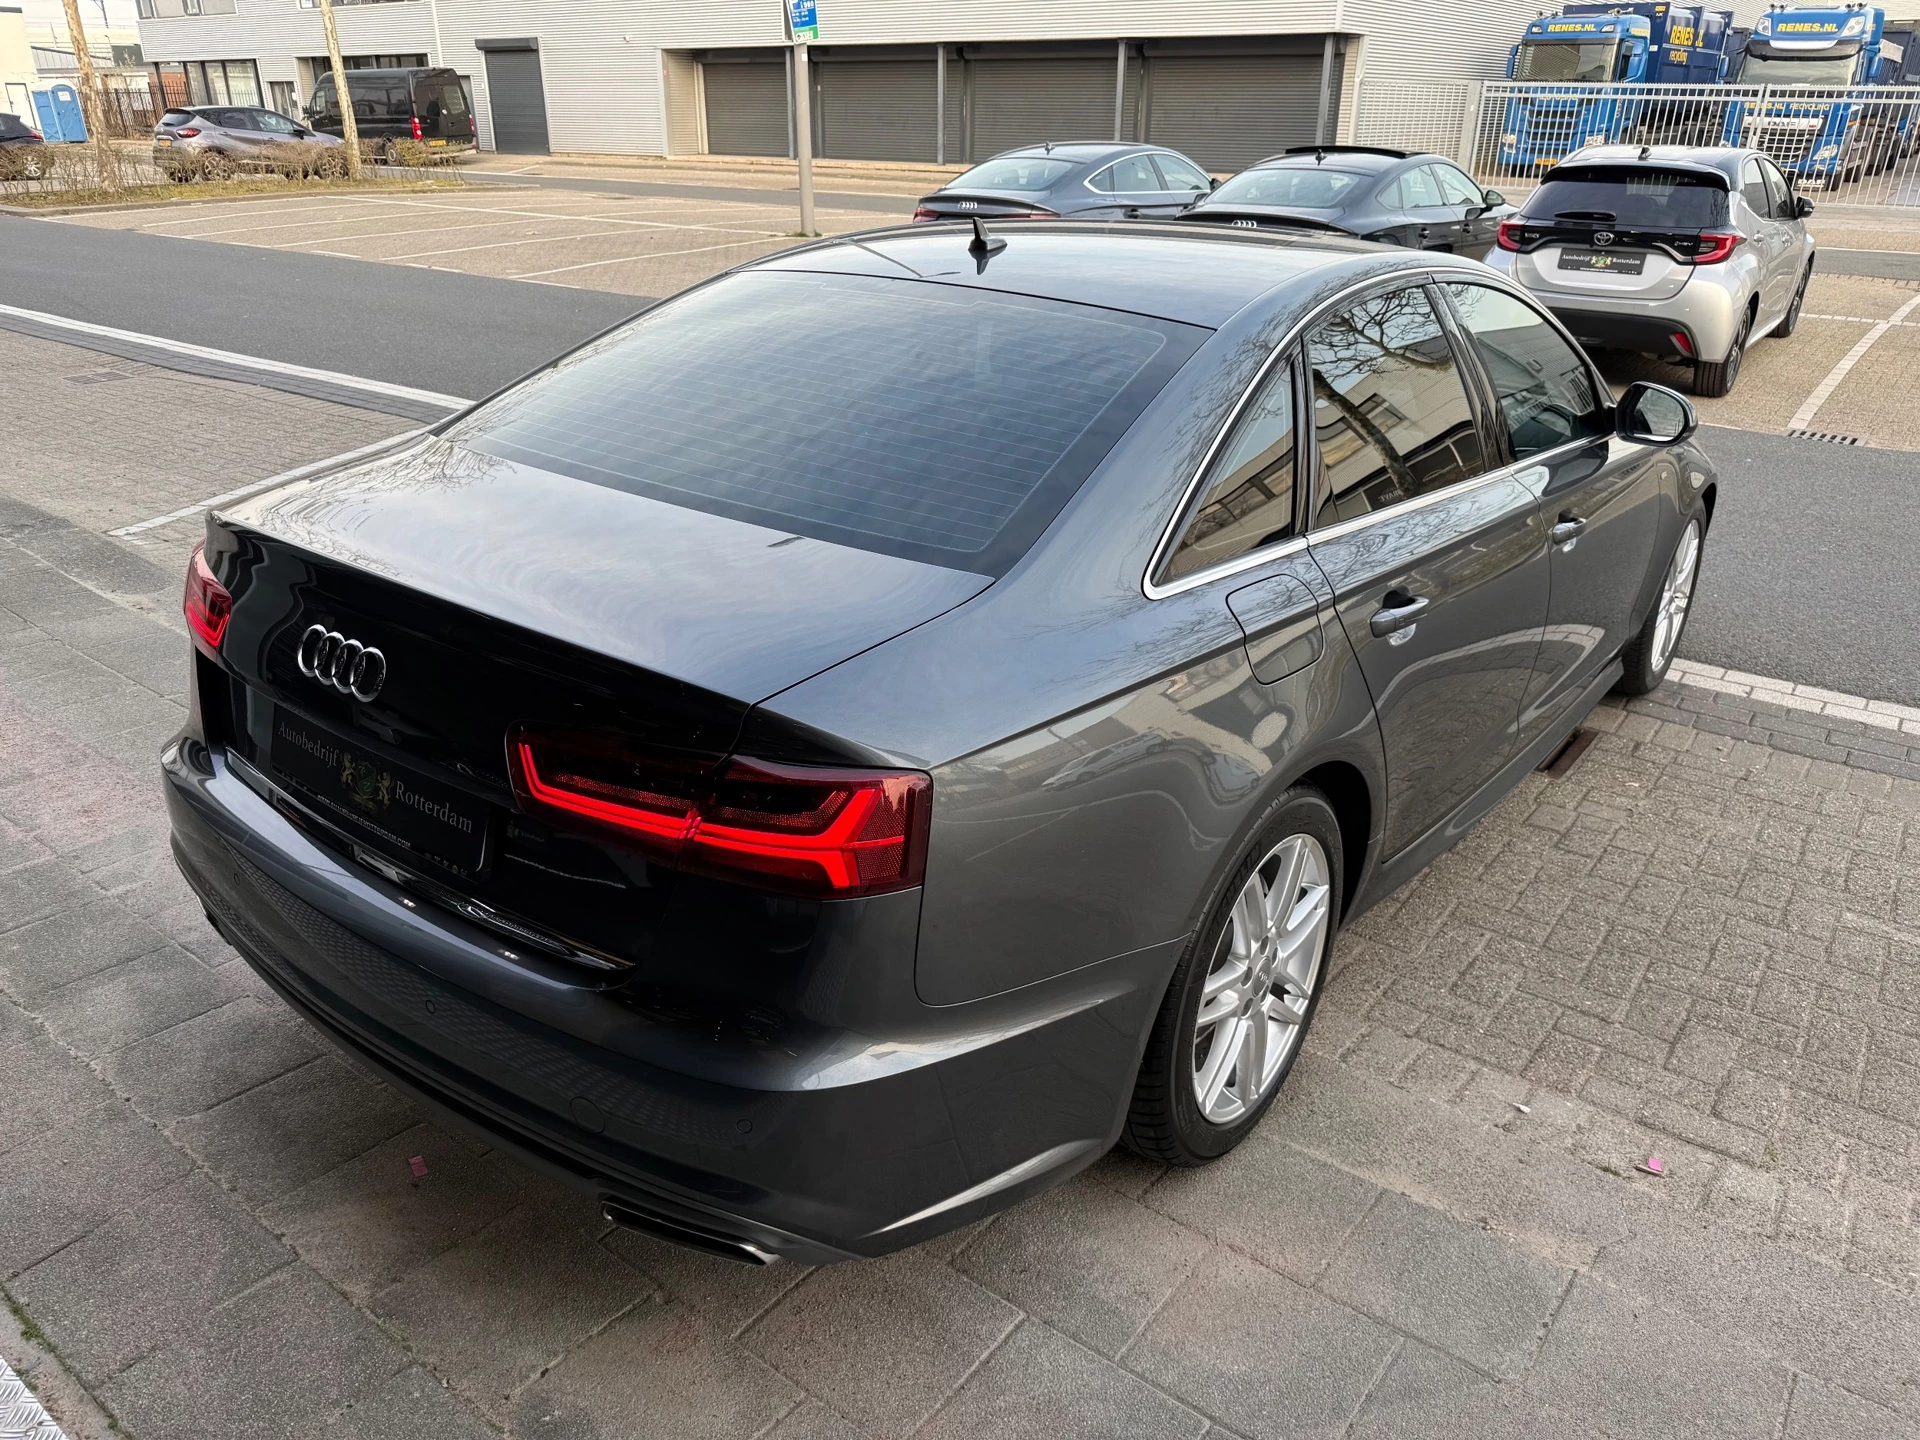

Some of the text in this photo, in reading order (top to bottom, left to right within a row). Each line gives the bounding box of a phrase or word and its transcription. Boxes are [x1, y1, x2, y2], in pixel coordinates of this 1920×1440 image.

[1548, 24, 1597, 32] RENES.NL
[1777, 23, 1838, 32] RENES.NL
[1744, 102, 1829, 111] RES.NL RECYCLING
[278, 721, 473, 834] Autobedrijf Rotterdam
